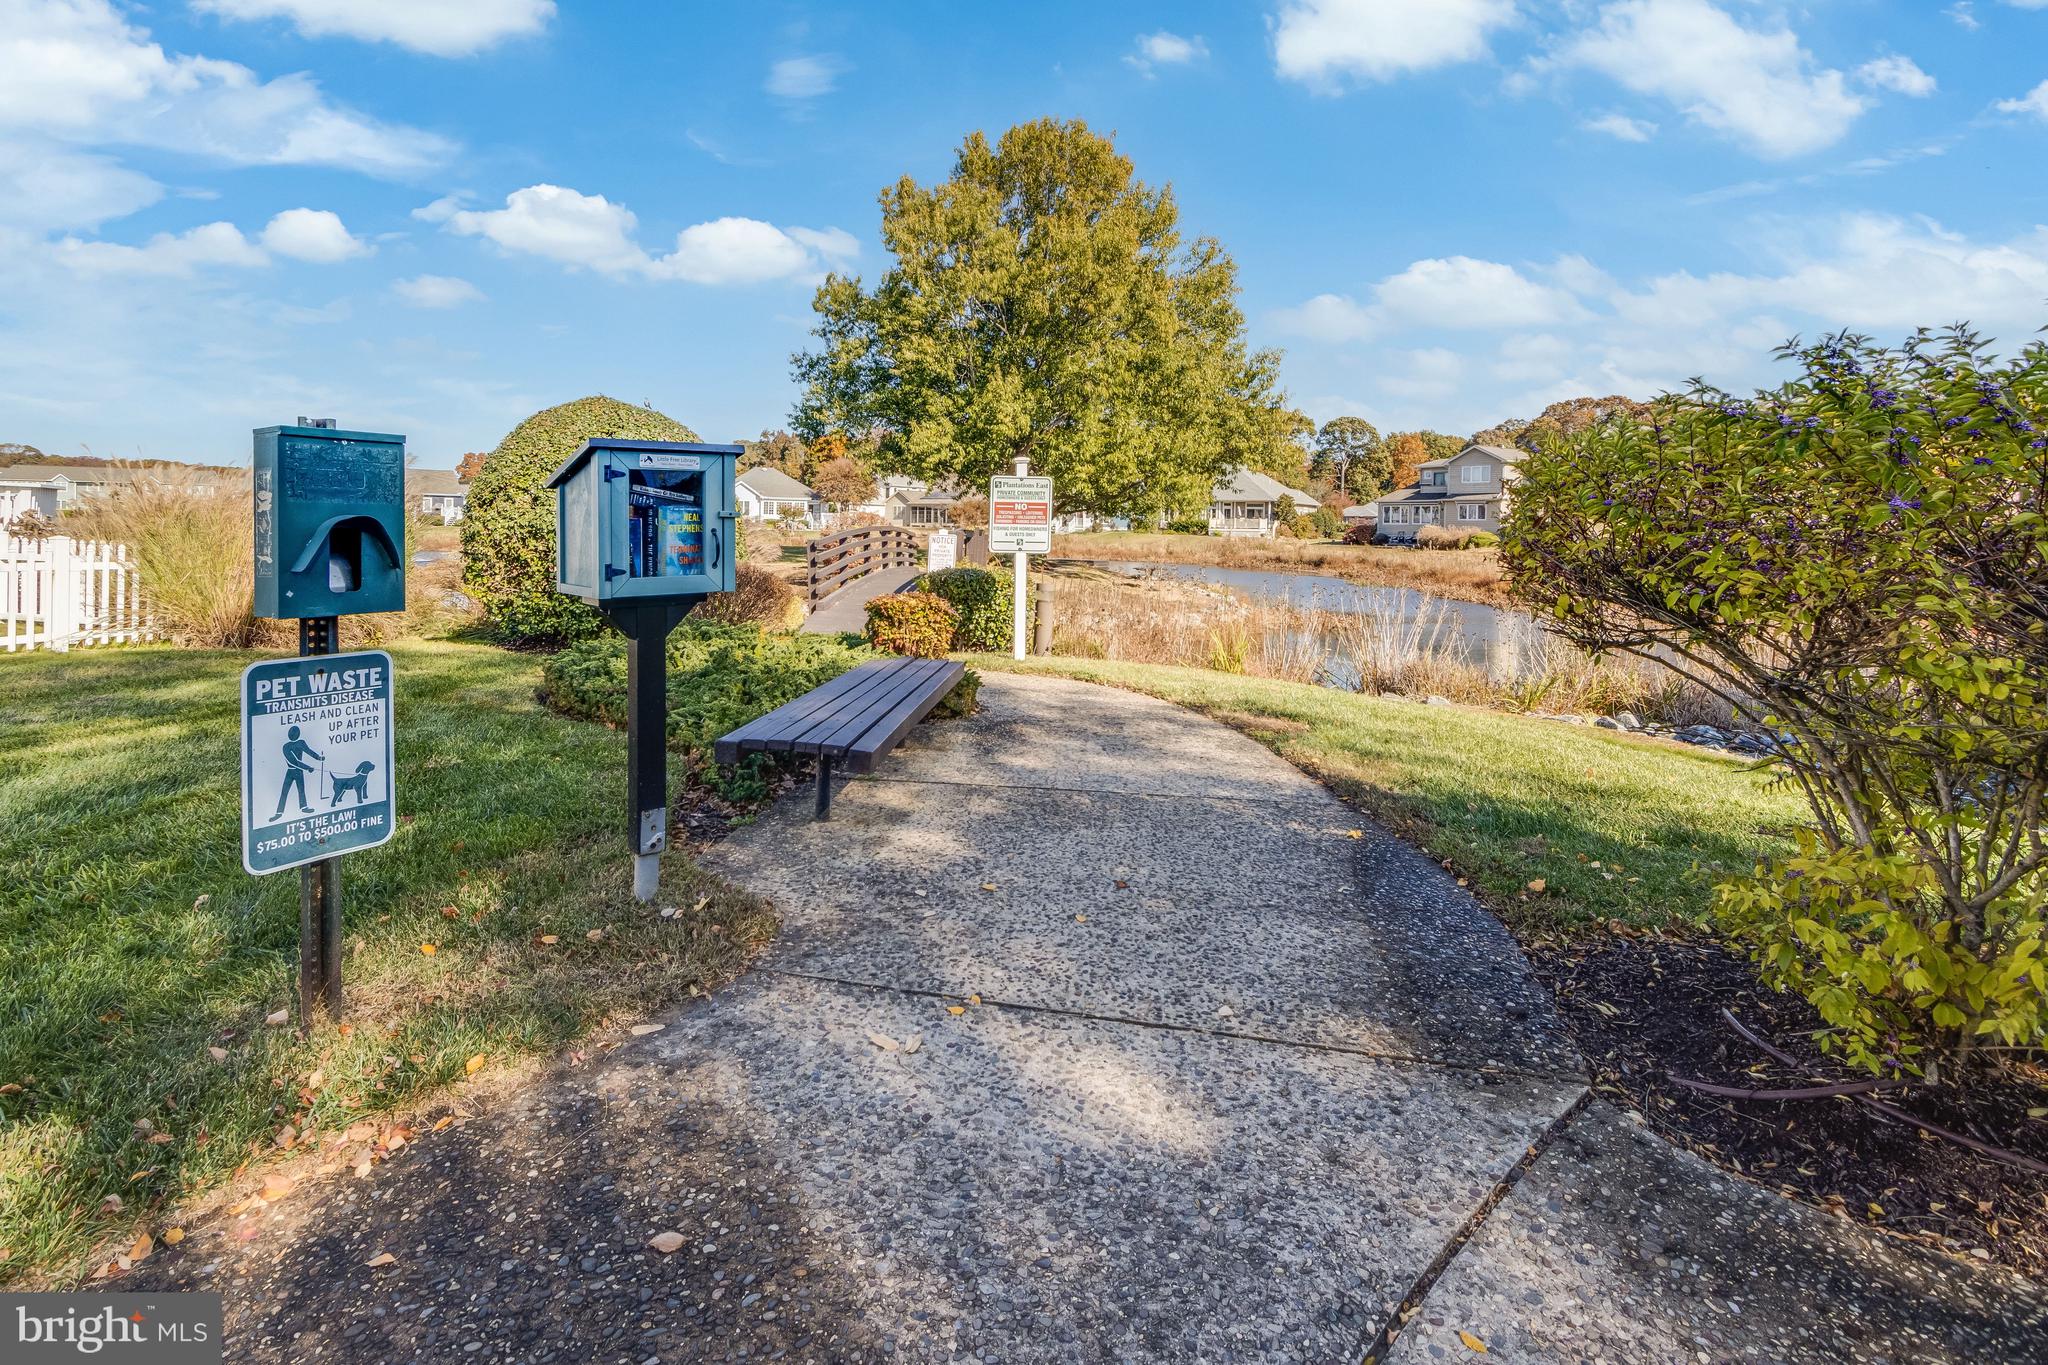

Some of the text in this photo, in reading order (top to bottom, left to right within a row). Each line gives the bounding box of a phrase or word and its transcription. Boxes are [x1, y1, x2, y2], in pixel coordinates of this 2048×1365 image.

[683, 513, 700, 522] NEAL
[256, 667, 382, 700] PET WASTE
[264, 689, 375, 713] TRANSMITS DISEASE
[280, 702, 379, 726] LEASH AND CLEAN
[328, 715, 379, 732] UP AFTER
[328, 728, 380, 745] YOUR PET
[256, 814, 384, 854] $75.00 TO $500.00 FINE
[286, 810, 357, 835] IT'S THE LAW!
